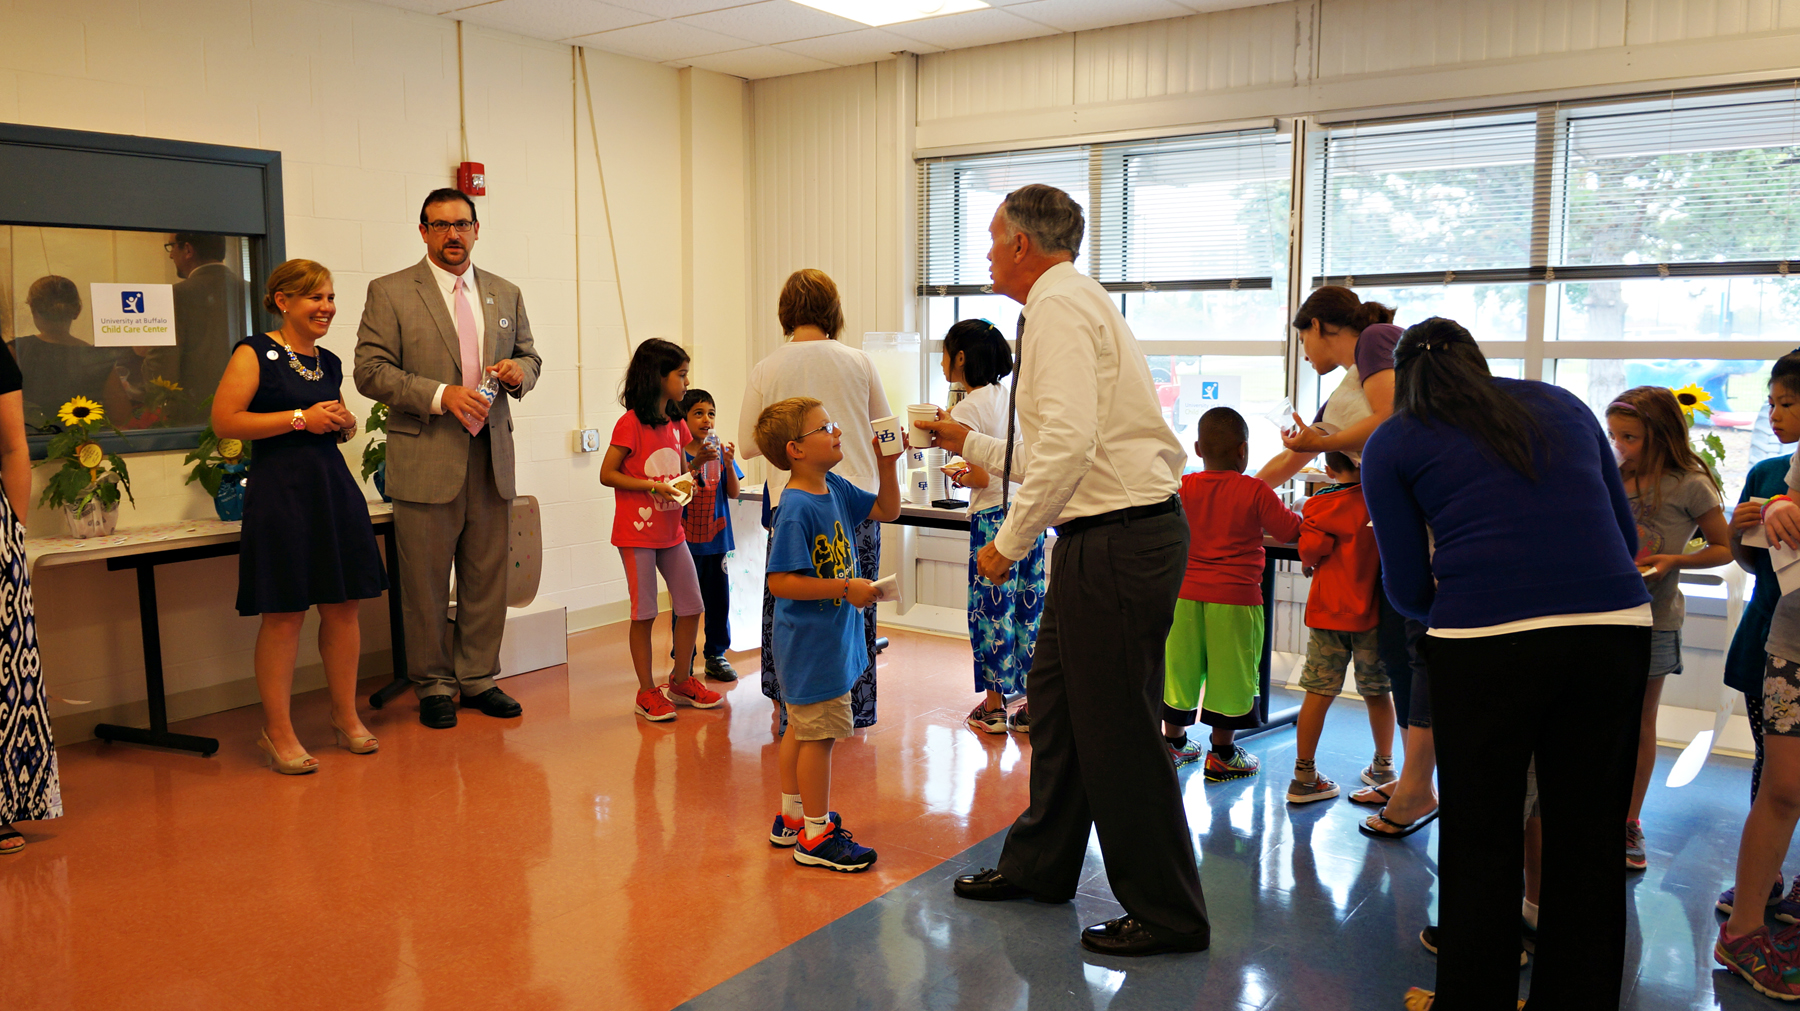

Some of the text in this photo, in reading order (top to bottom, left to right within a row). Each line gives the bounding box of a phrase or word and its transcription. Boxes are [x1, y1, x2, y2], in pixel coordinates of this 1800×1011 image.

[101, 325, 168, 333] Child Care Center
